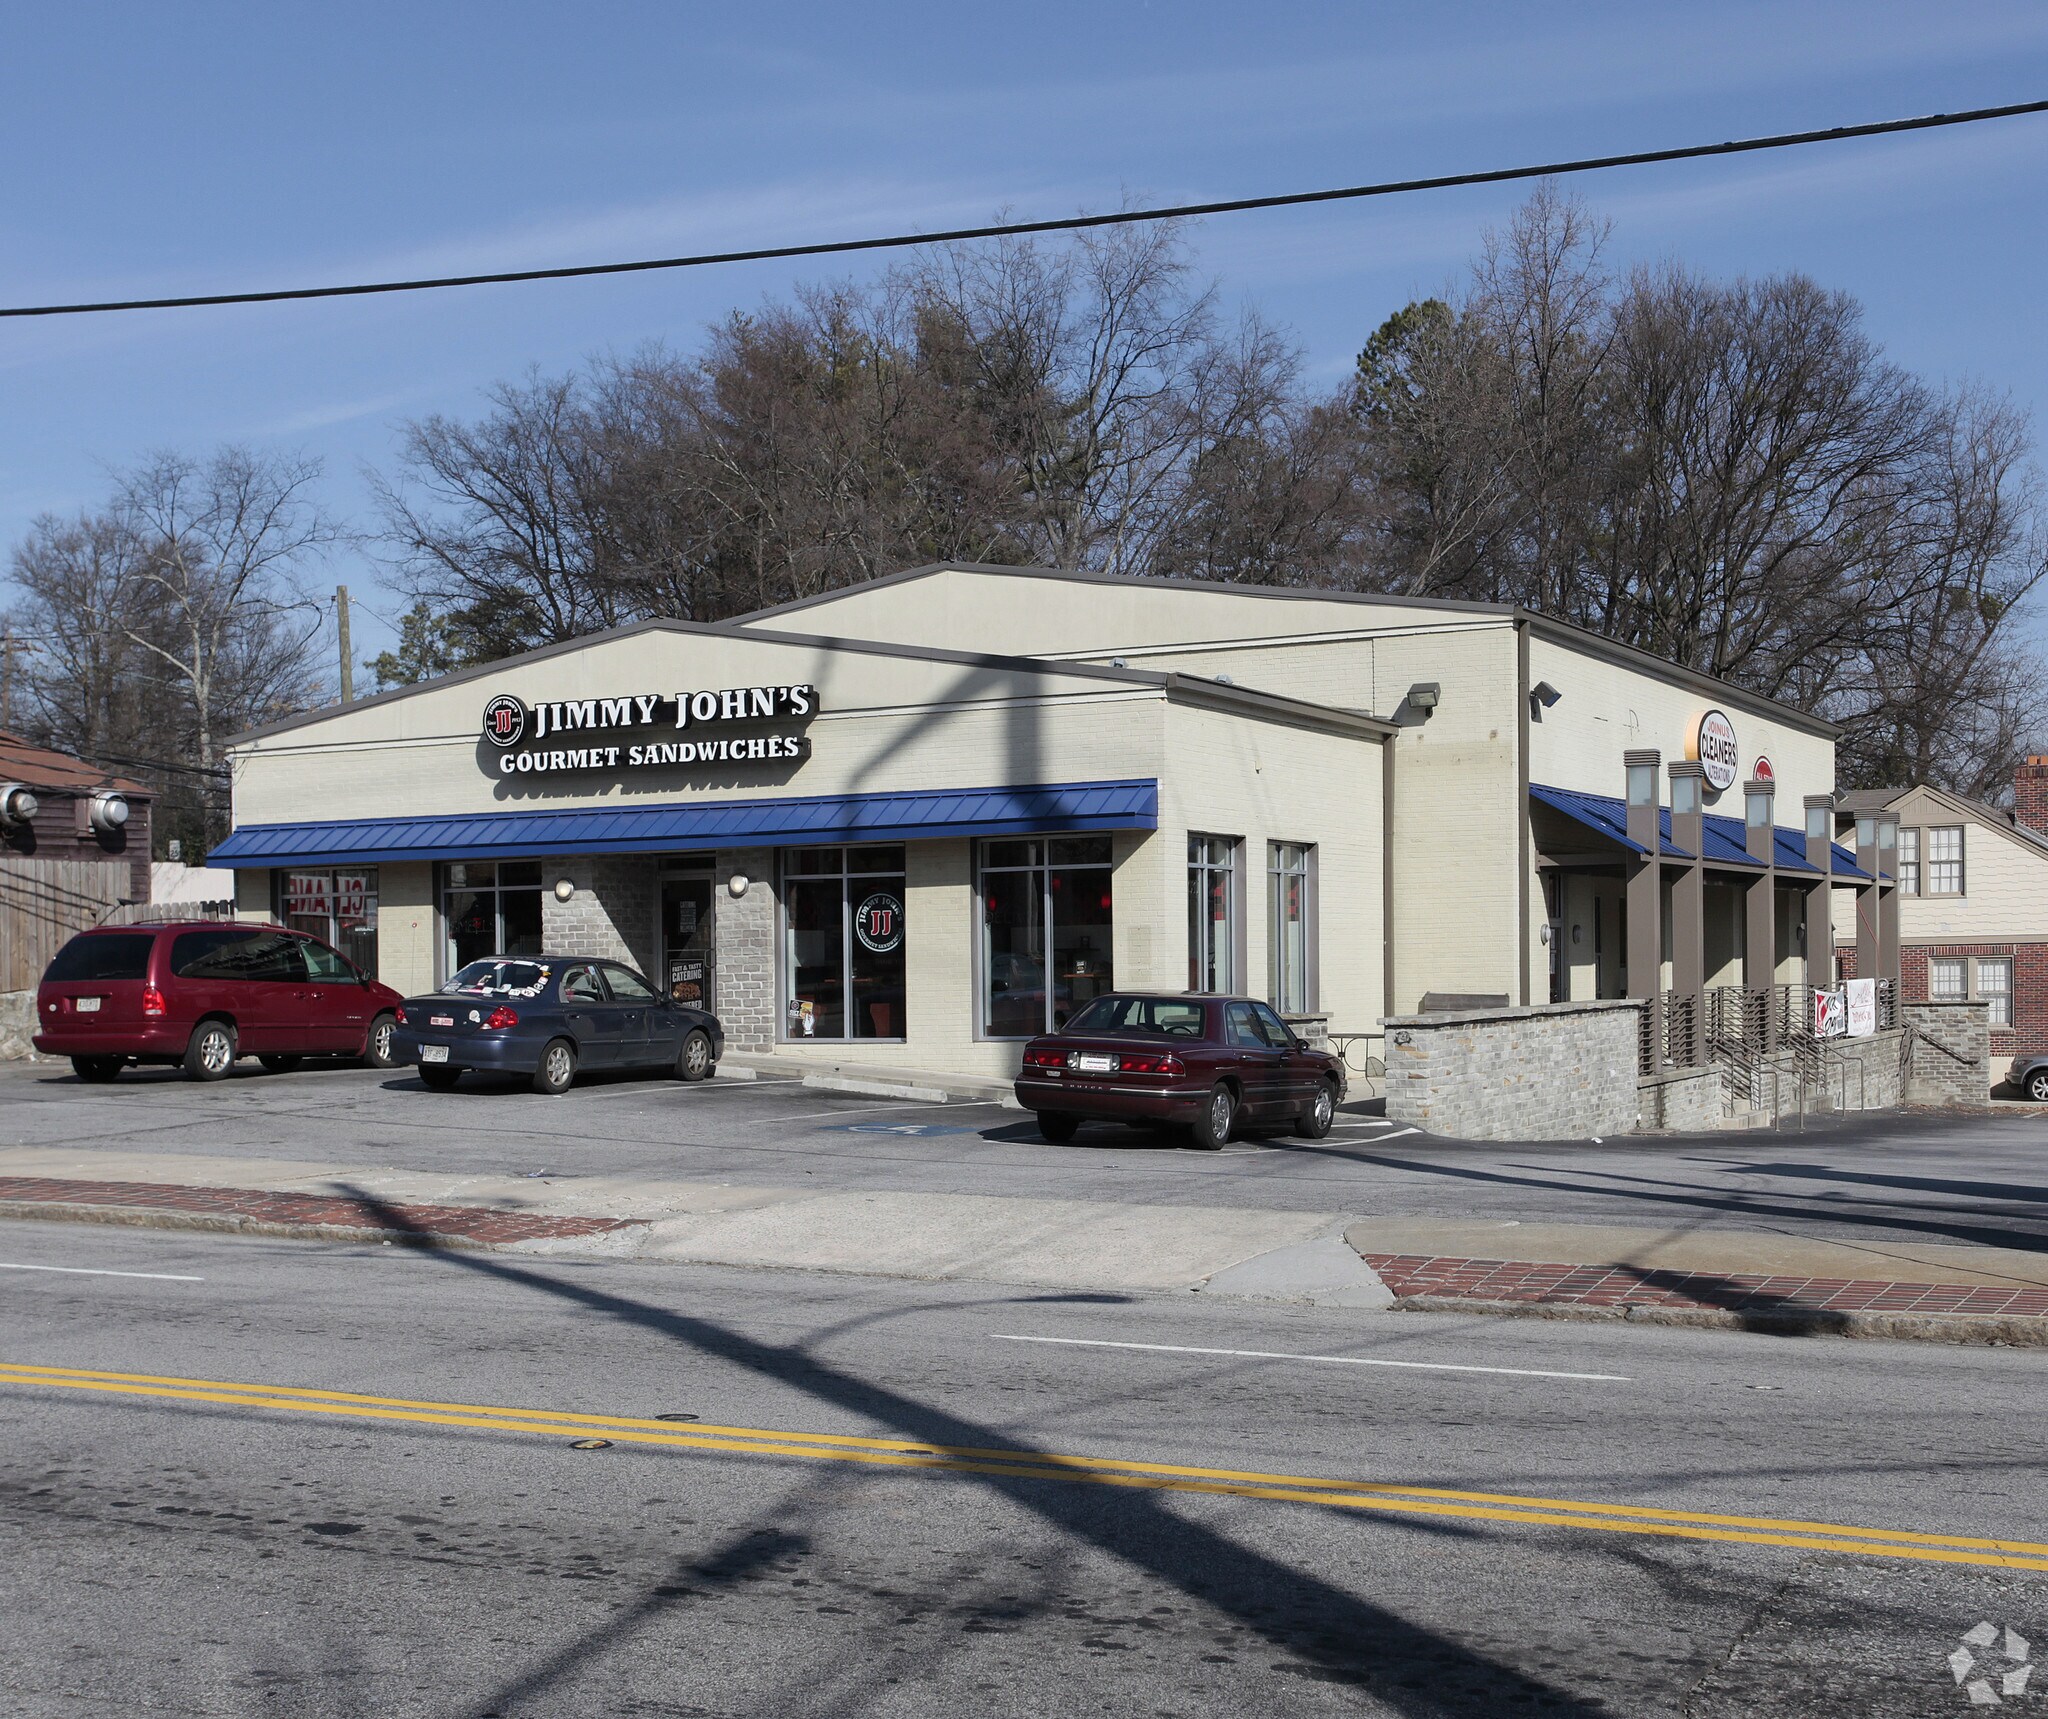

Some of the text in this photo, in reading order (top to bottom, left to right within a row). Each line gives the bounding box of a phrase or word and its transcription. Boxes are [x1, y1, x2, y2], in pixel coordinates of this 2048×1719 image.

[495, 709, 511, 733] JJ
[535, 685, 809, 738] JIMMY JOHN'S
[500, 736, 799, 774] GOURMET SANDWICHES
[1702, 733, 1736, 767] CLEANERS
[871, 910, 892, 936] JJ
[672, 969, 702, 982] CATERING
